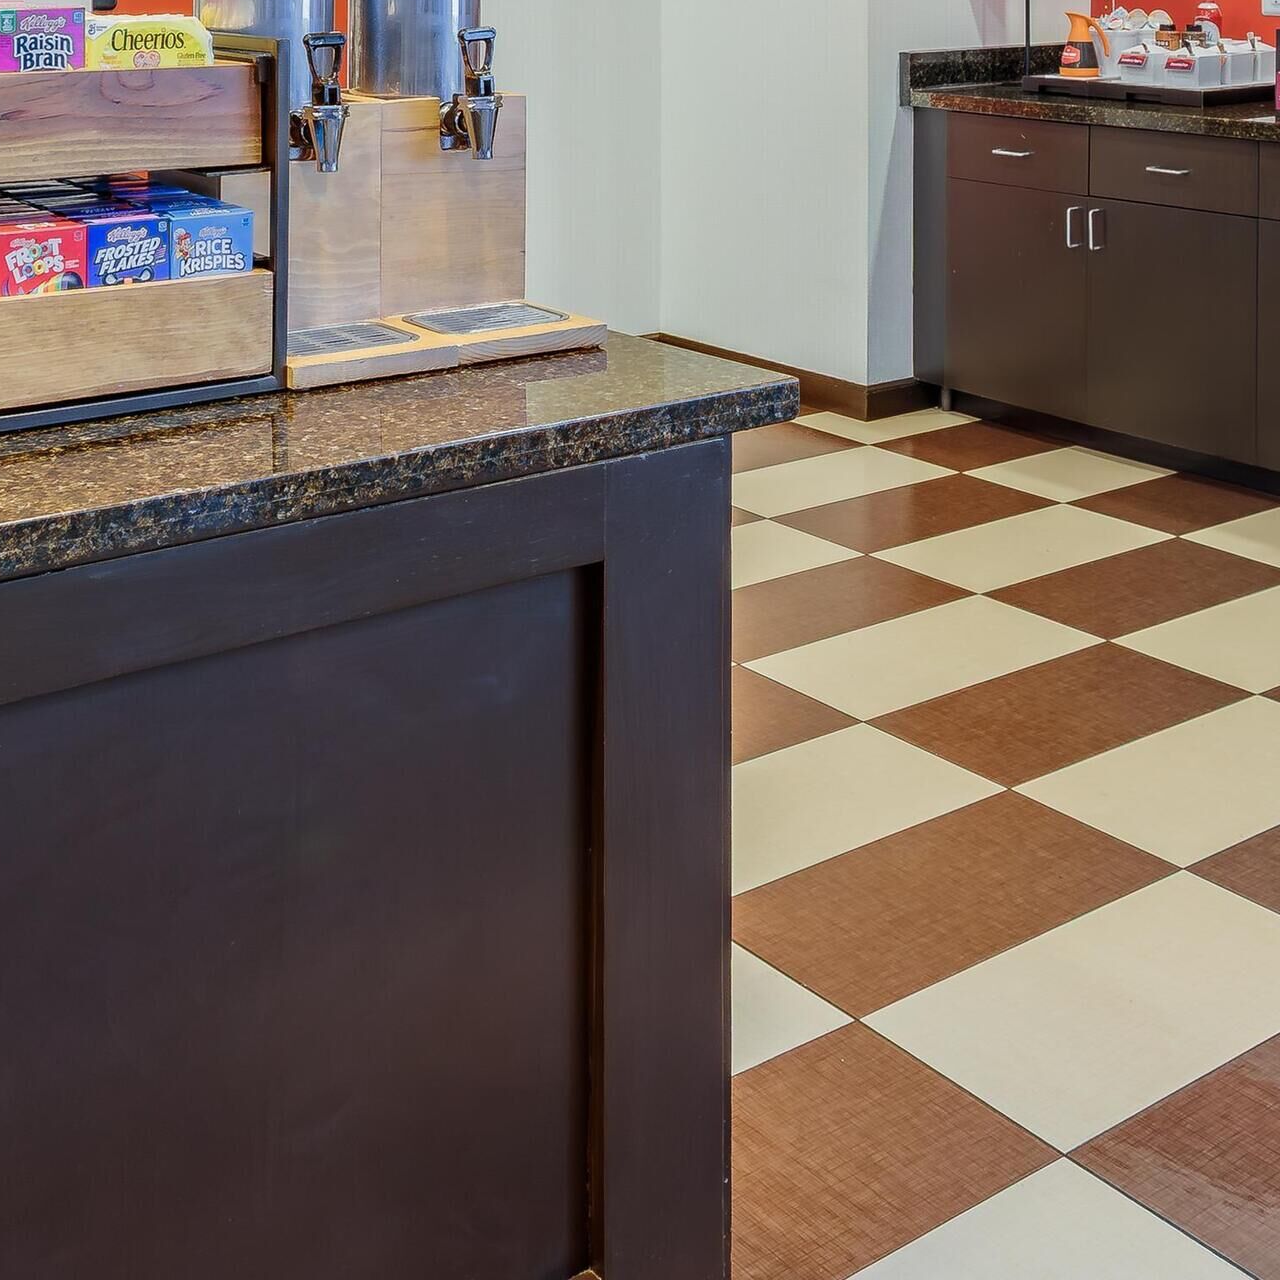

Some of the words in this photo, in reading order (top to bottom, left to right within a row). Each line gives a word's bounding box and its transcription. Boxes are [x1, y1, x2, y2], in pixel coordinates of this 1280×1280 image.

[20, 15, 67, 32] Kellogg's
[14, 33, 73, 58] Raisin
[111, 27, 185, 52] Cheerios
[21, 51, 68, 72] Bran
[5, 238, 62, 272] FROOT
[95, 237, 161, 265] FROSTED
[195, 237, 233, 258] RICE
[12, 254, 65, 285] LOOPS
[99, 251, 156, 276] FLAKES
[179, 253, 245, 277] KRISPIES
